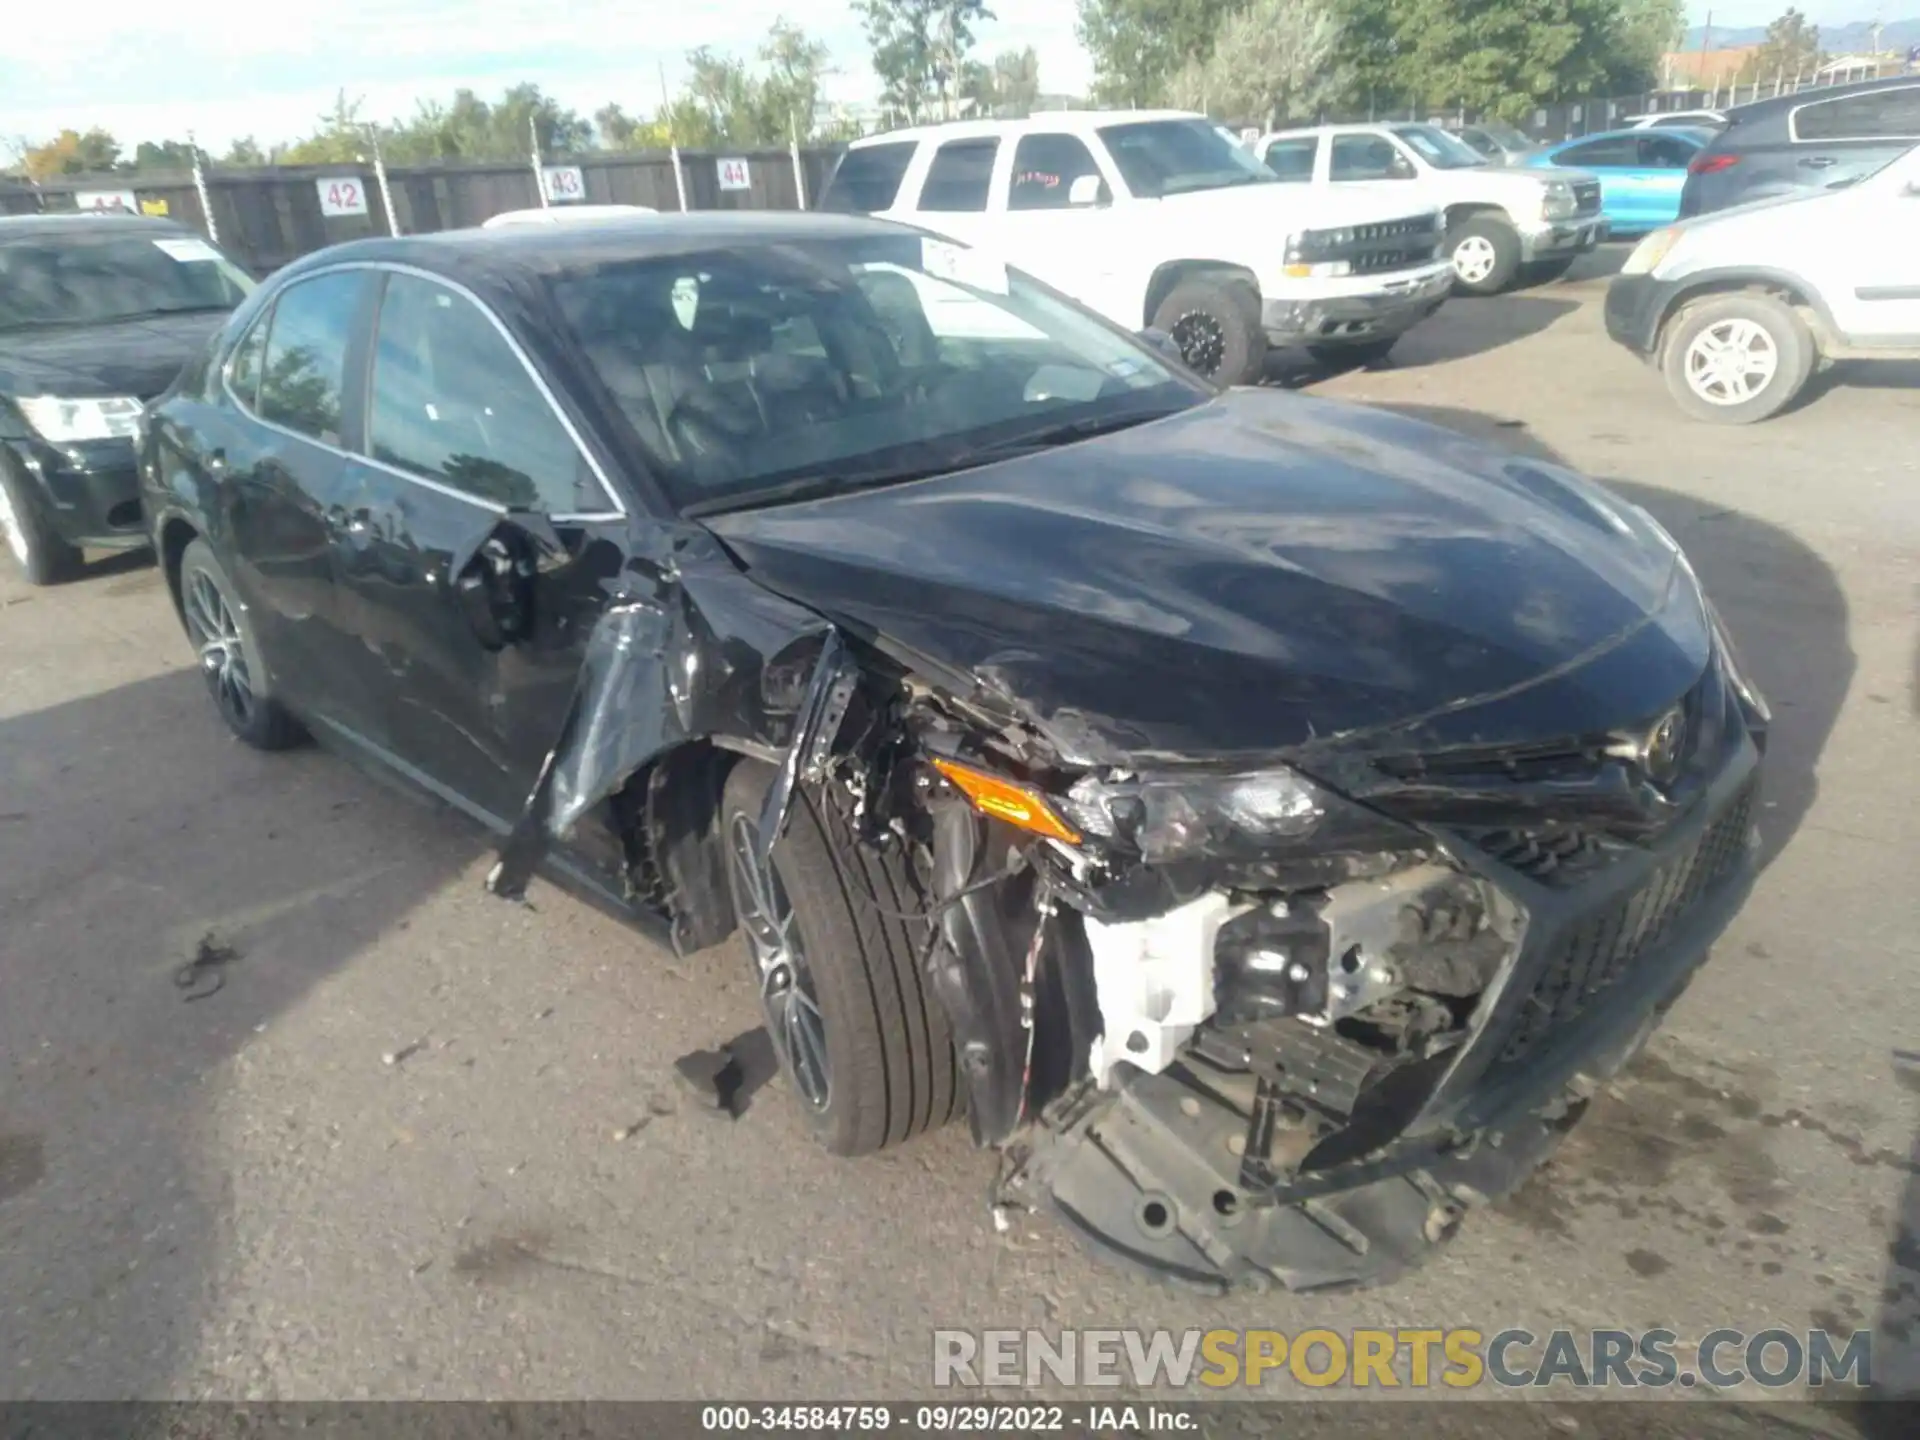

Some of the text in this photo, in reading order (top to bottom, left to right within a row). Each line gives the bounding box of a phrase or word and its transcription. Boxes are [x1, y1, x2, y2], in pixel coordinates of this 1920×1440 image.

[552, 171, 579, 194] 43
[724, 162, 745, 185] 44
[328, 183, 360, 208] 42
